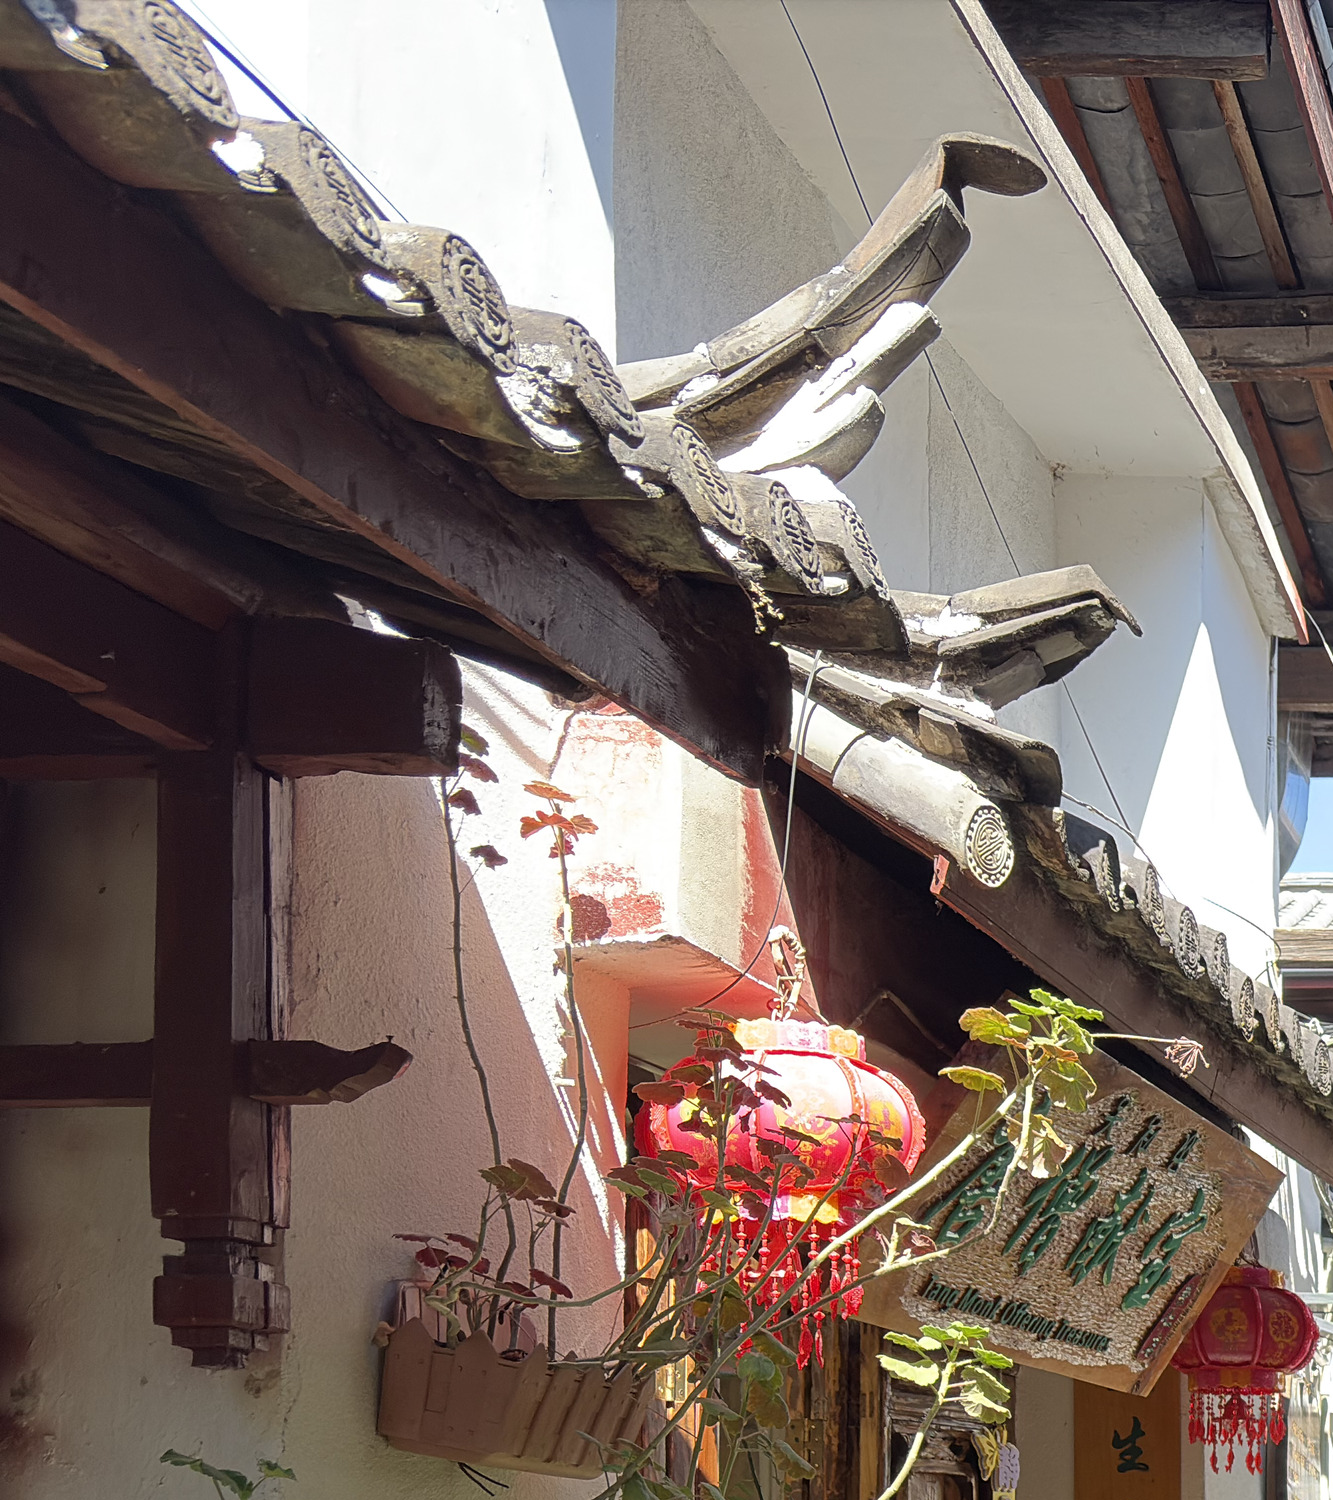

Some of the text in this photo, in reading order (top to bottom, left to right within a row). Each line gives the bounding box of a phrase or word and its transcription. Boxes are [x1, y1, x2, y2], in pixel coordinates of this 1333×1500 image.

[922, 1273, 959, 1313] Tang
[957, 1284, 1001, 1321] Monk
[1000, 1301, 1056, 1342] Offering
